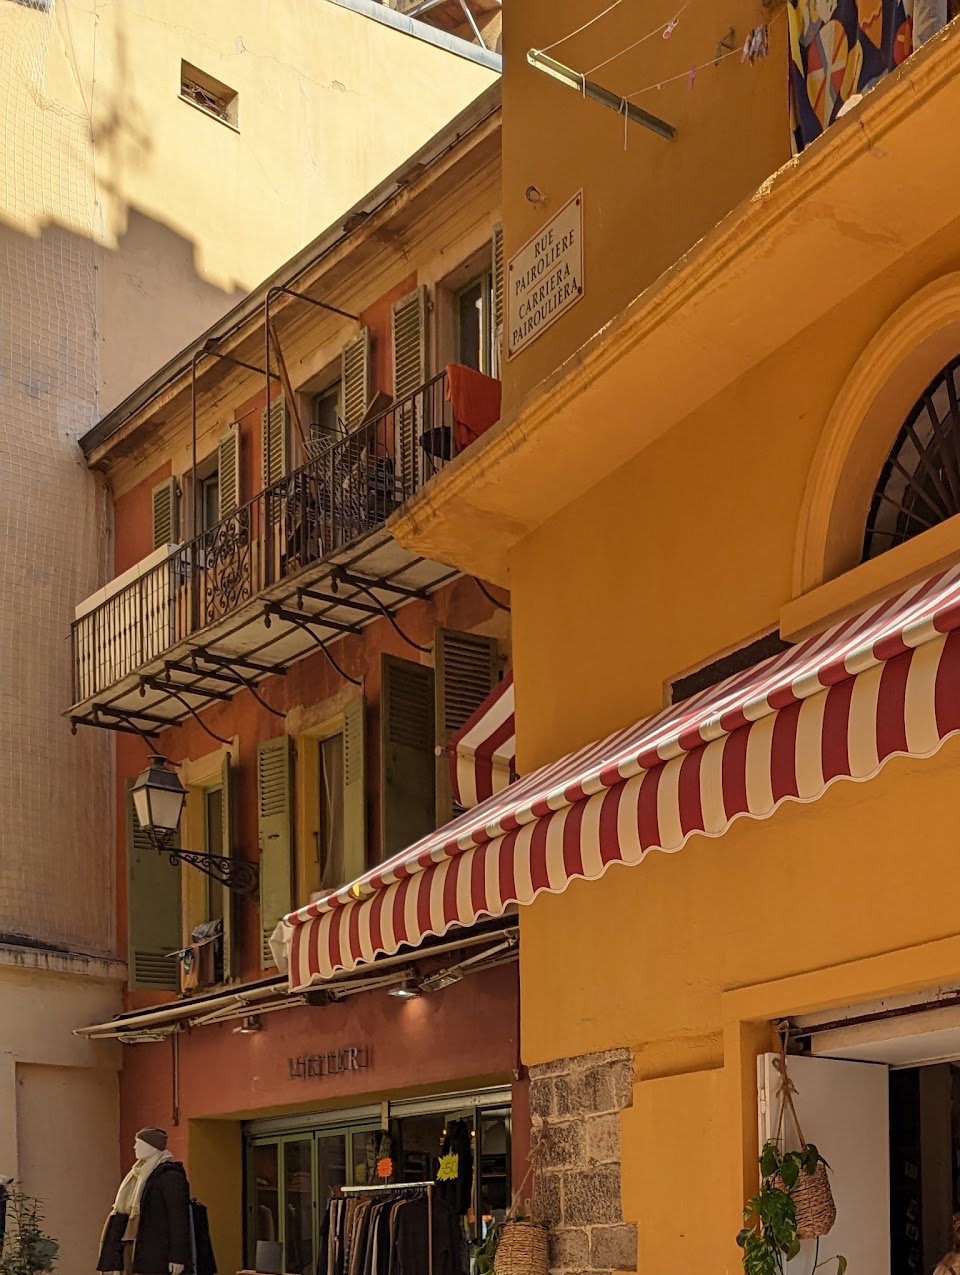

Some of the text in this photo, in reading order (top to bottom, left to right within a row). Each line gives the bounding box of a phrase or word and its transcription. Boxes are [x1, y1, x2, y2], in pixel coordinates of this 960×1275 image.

[515, 229, 575, 296] PAIROLIERE
[534, 228, 555, 259] RUE
[512, 277, 579, 347] PAIROULIÈRA
[518, 262, 571, 320] CARRIERA
